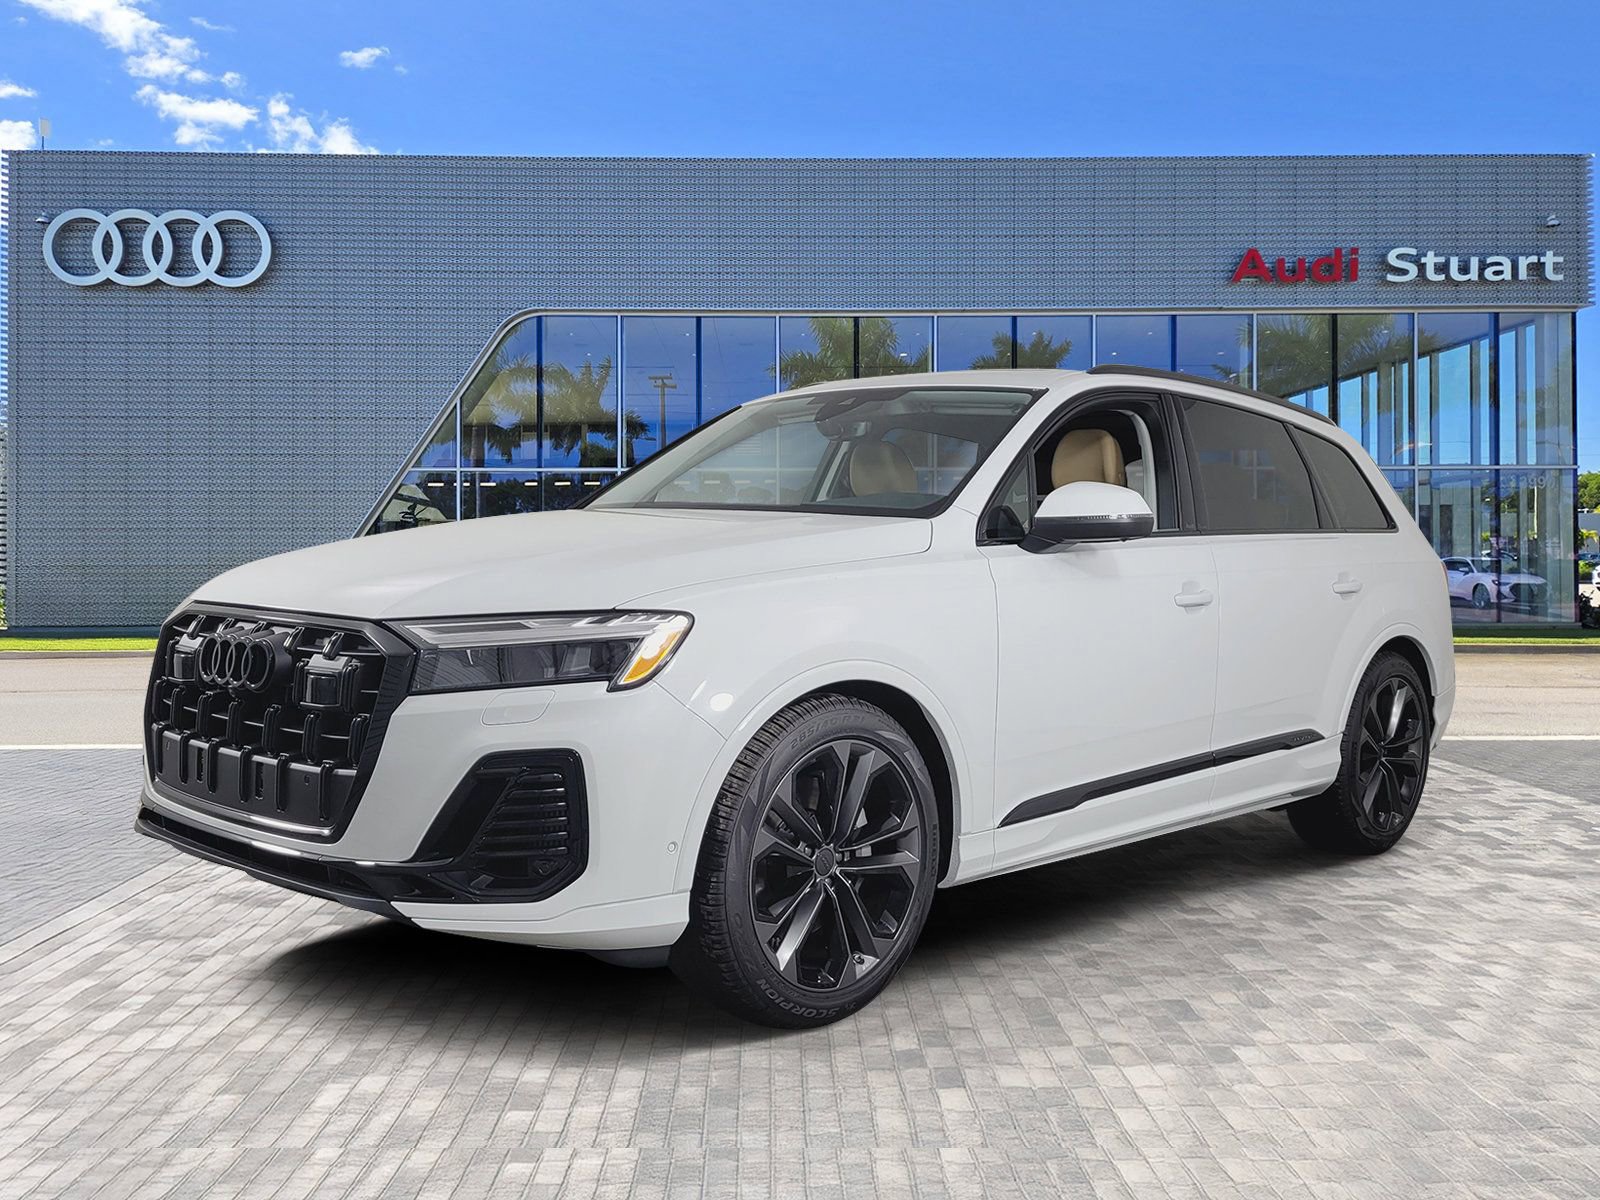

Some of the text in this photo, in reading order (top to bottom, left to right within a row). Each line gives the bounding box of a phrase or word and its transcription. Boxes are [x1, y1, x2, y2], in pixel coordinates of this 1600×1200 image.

[1231, 246, 1564, 283] Audi Stuart
[757, 977, 840, 1019] SCORPION
